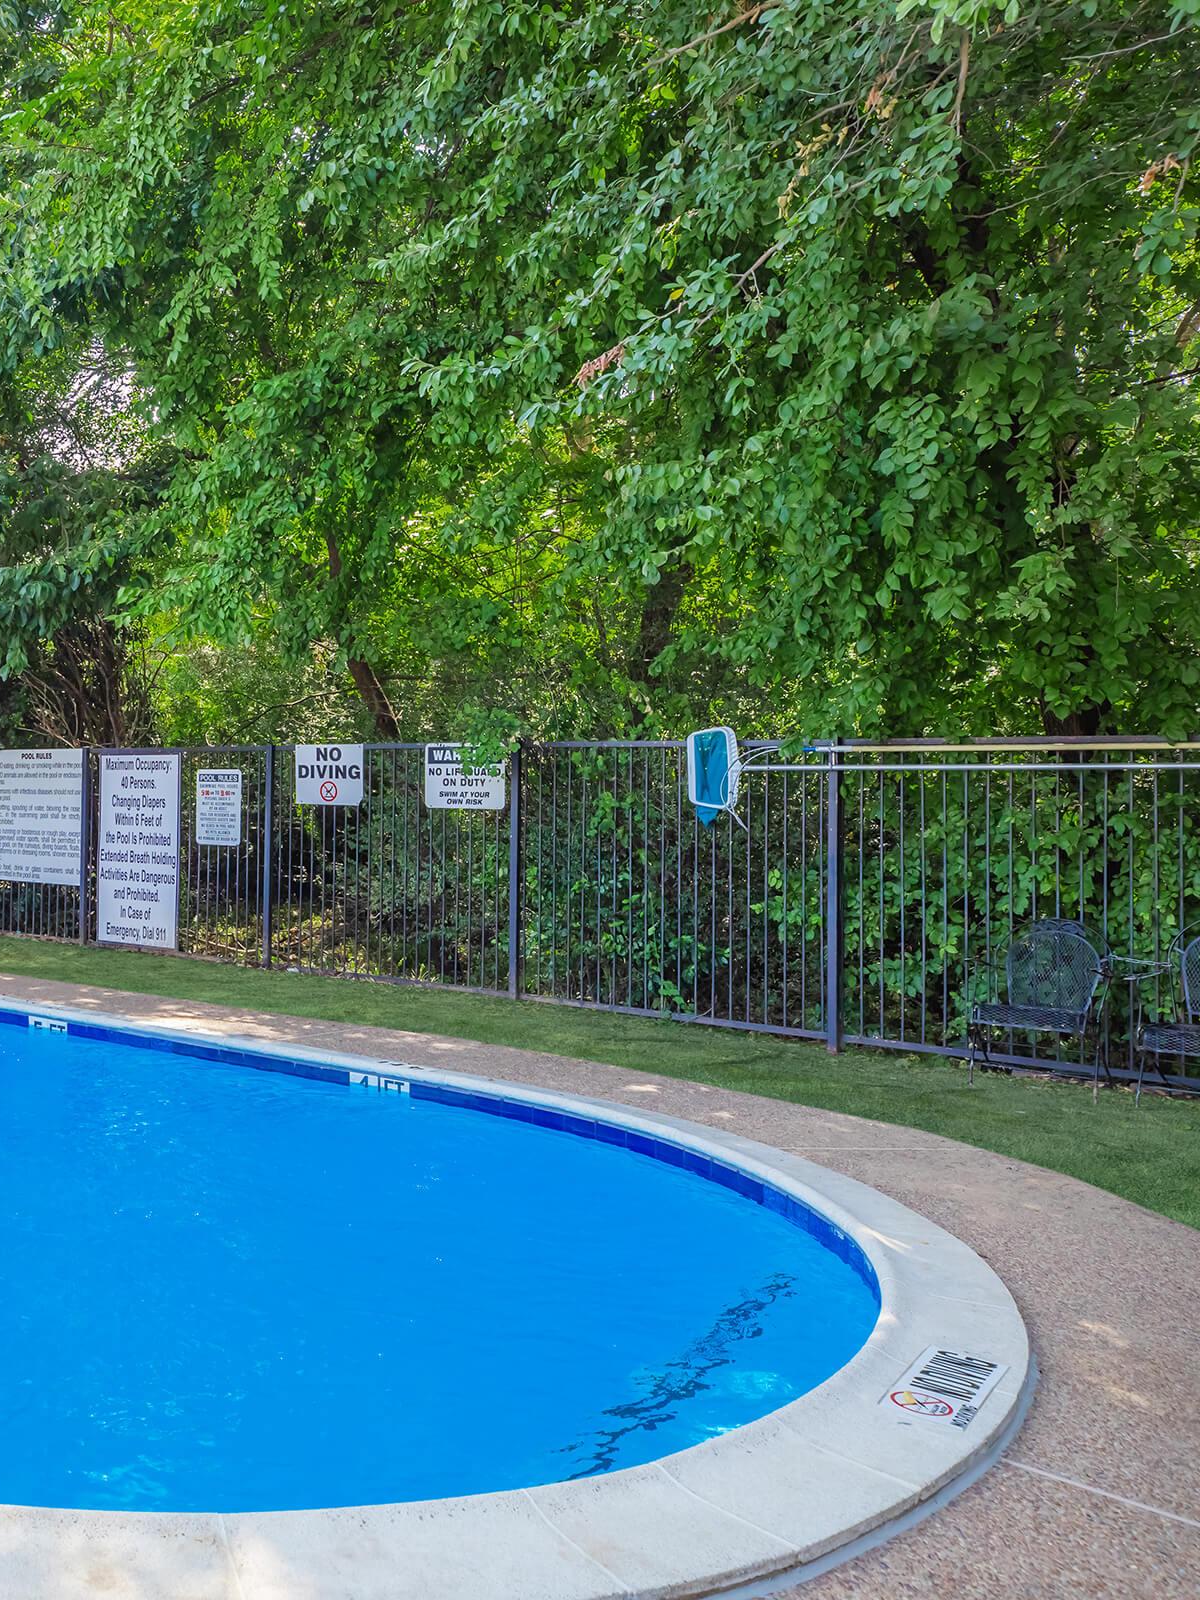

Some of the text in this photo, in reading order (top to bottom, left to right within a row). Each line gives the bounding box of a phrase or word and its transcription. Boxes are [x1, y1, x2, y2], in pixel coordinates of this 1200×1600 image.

[316, 747, 342, 761] NO
[105, 758, 172, 774] Maximum Occupancy:
[298, 765, 360, 780] DIVING
[428, 768, 442, 776] NO
[120, 776, 157, 789] 40 Persons.
[442, 778, 486, 787] ON DUTY
[112, 794, 166, 811] Changing Diapers
[115, 813, 162, 827] Within 6 Feet of
[105, 831, 171, 846] the Pool Is Prohibited
[100, 849, 176, 869] Extended Breath Holding
[100, 867, 176, 886] Activities Are Dangerous
[113, 887, 160, 902] and Prohibited.
[120, 905, 151, 920] In Case of
[106, 922, 166, 941] Emergency, Dial 911
[359, 1075, 405, 1094] 4 FT
[909, 1350, 998, 1403] NO DIVING
